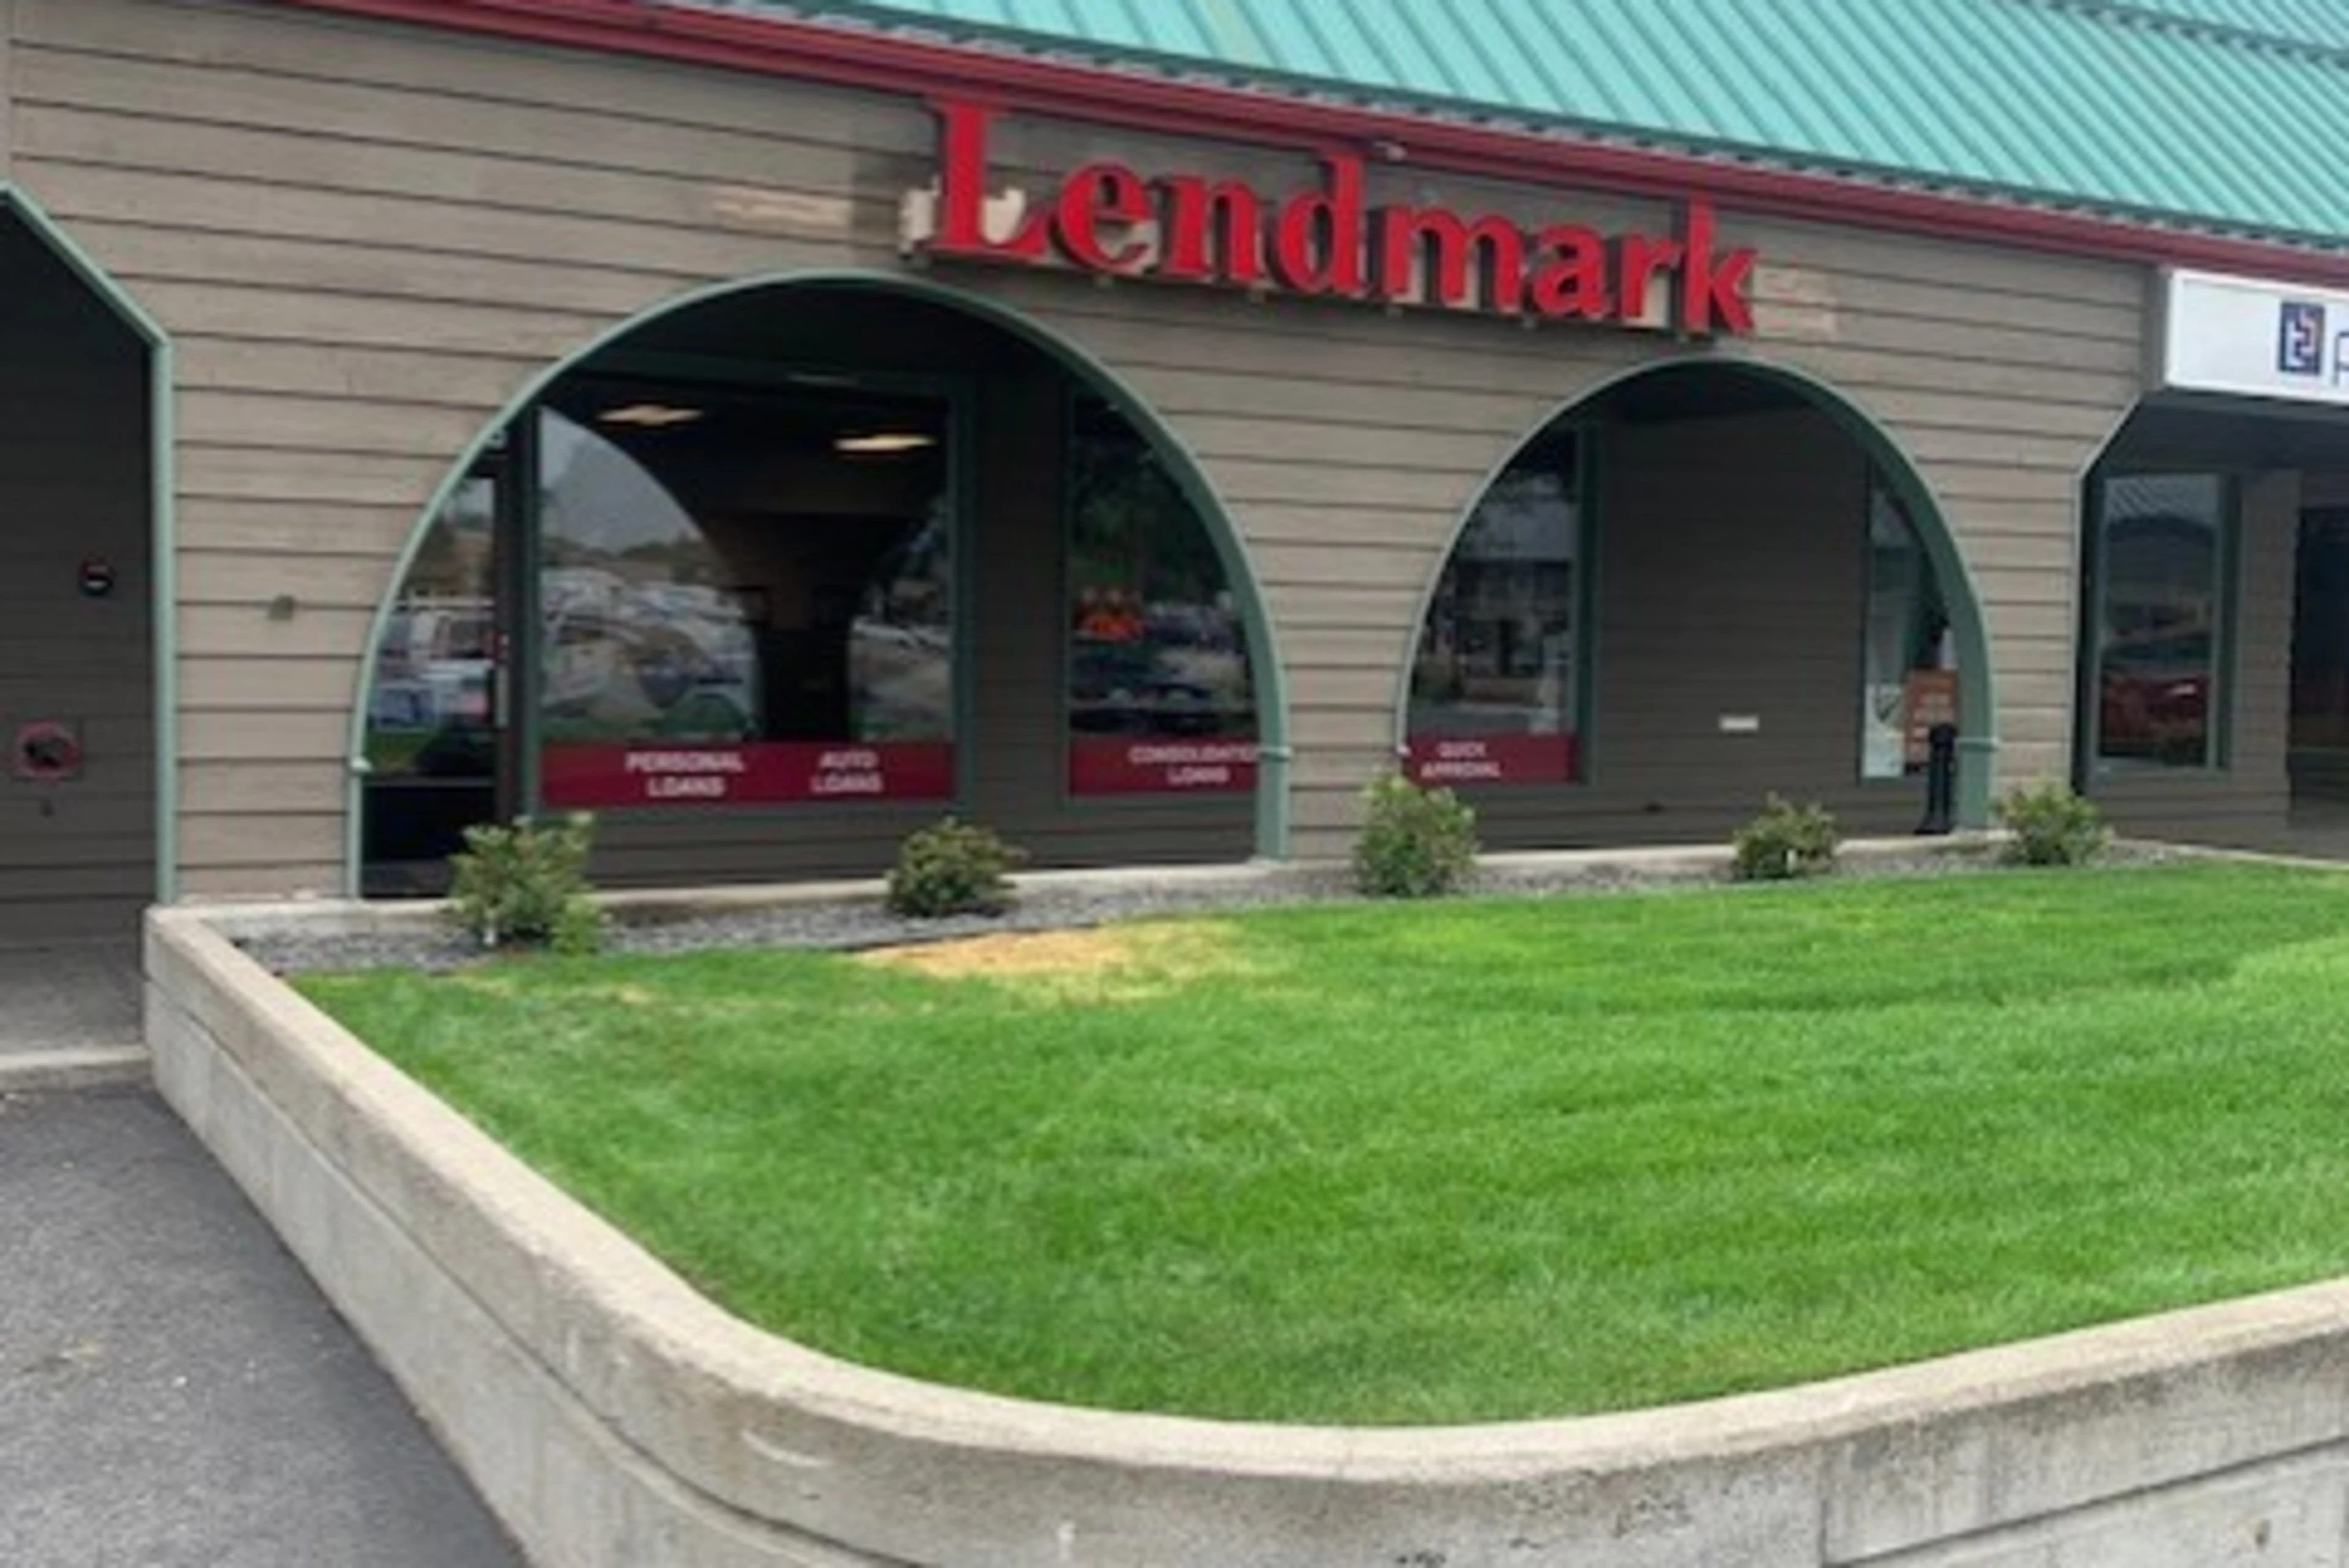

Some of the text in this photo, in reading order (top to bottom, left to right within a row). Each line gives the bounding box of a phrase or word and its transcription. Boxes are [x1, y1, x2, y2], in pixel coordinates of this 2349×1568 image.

[930, 98, 1757, 335] Lendmark
[625, 750, 746, 773] PERSONAL
[818, 751, 881, 770] AUTO
[646, 776, 727, 797] LOANS
[809, 773, 886, 794] LOANS
[1165, 766, 1231, 786] LOANS
